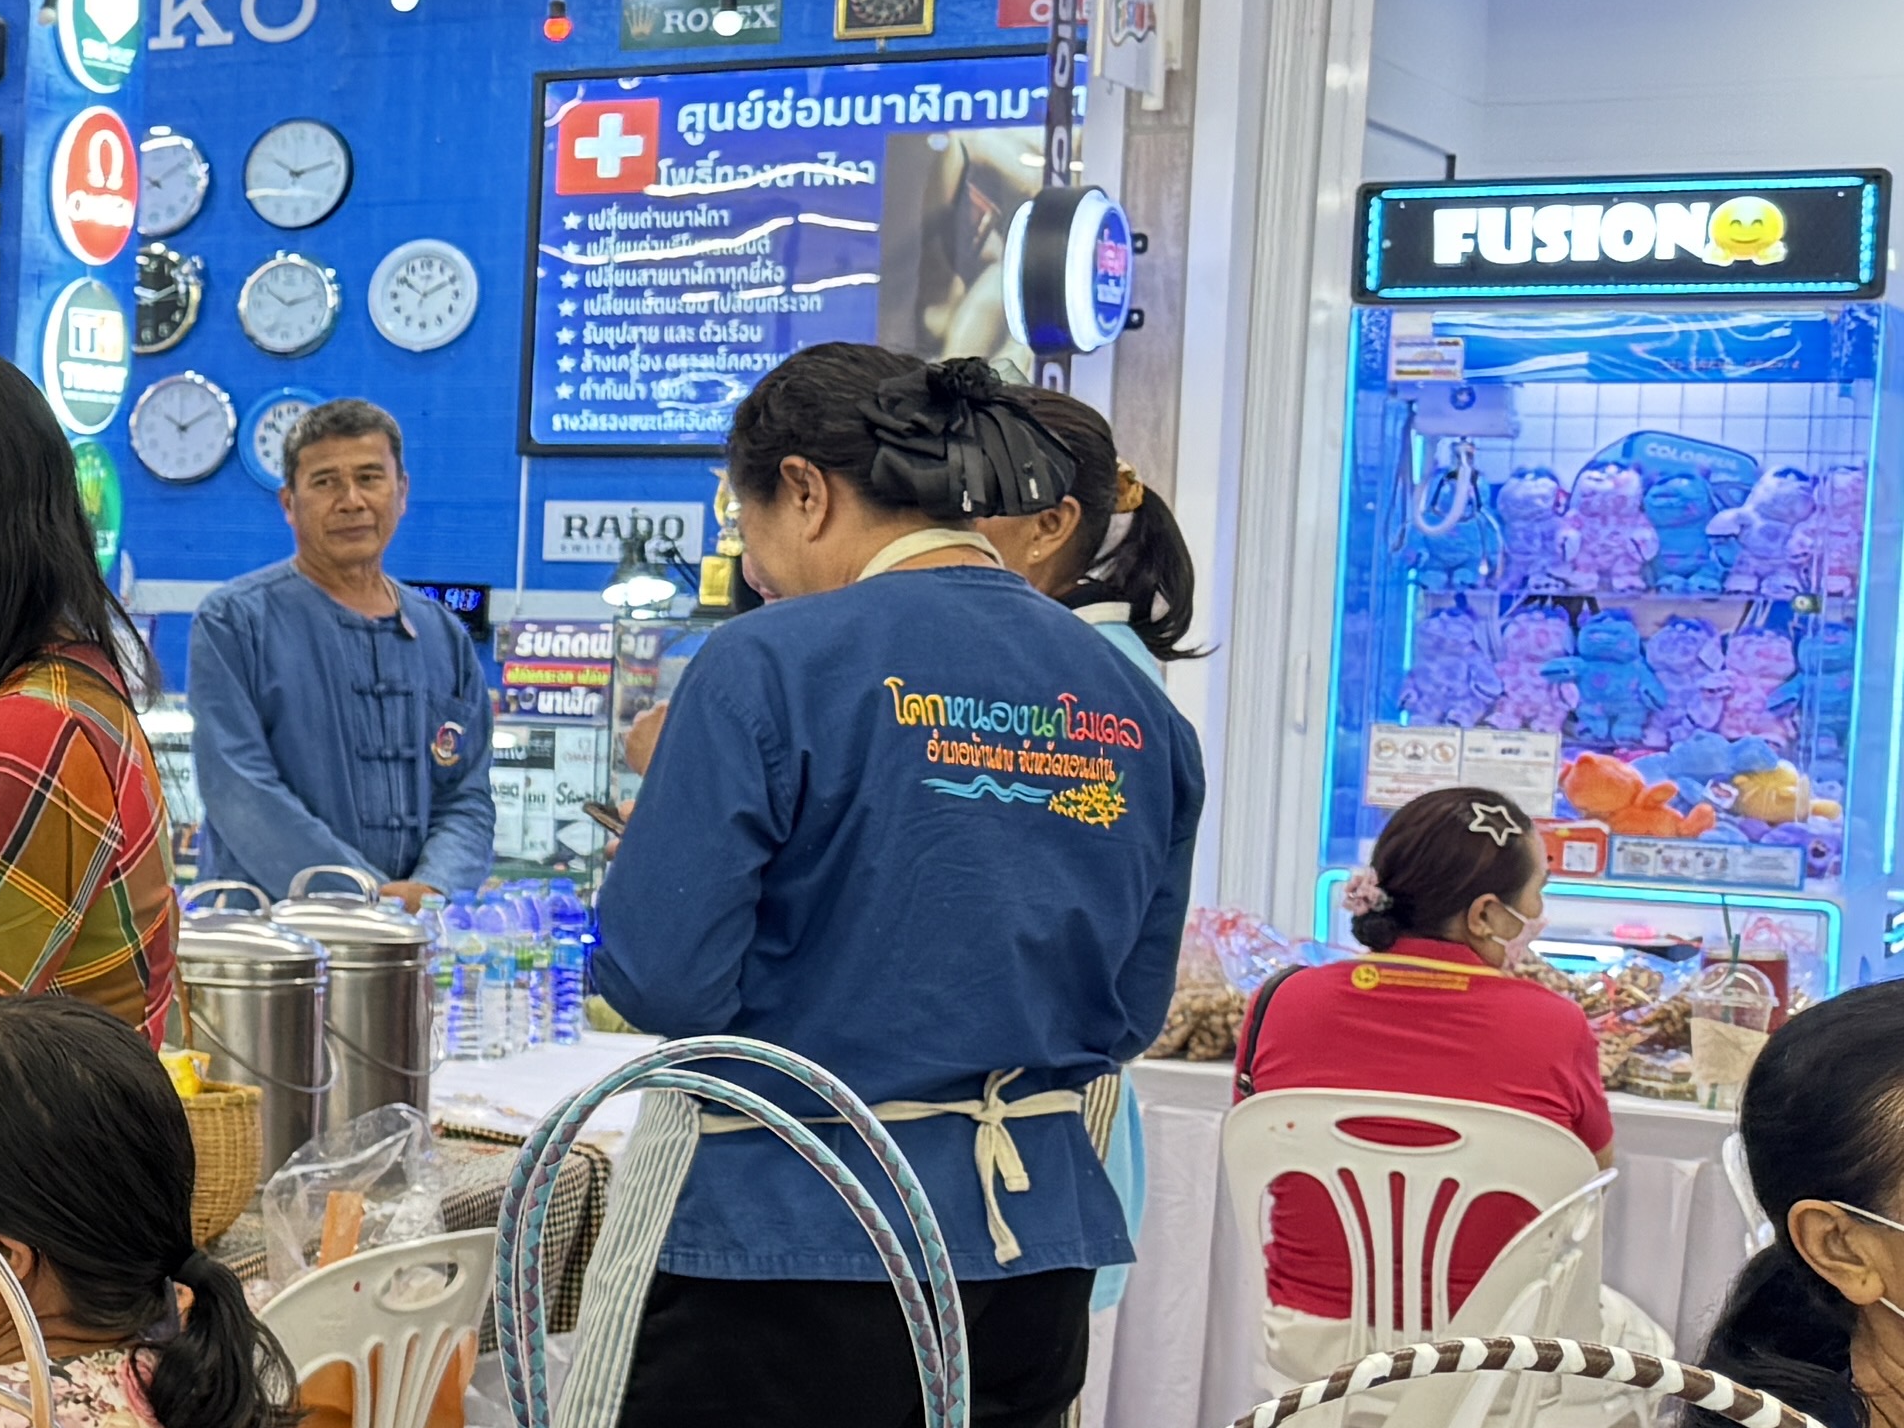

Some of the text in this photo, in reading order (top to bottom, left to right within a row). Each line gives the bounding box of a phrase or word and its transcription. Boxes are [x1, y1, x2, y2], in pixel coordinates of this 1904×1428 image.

[662, 2, 778, 36] ROEX
[1432, 201, 1712, 266] FUSION
[882, 675, 1143, 750] โคกหนองนาโมเดล
